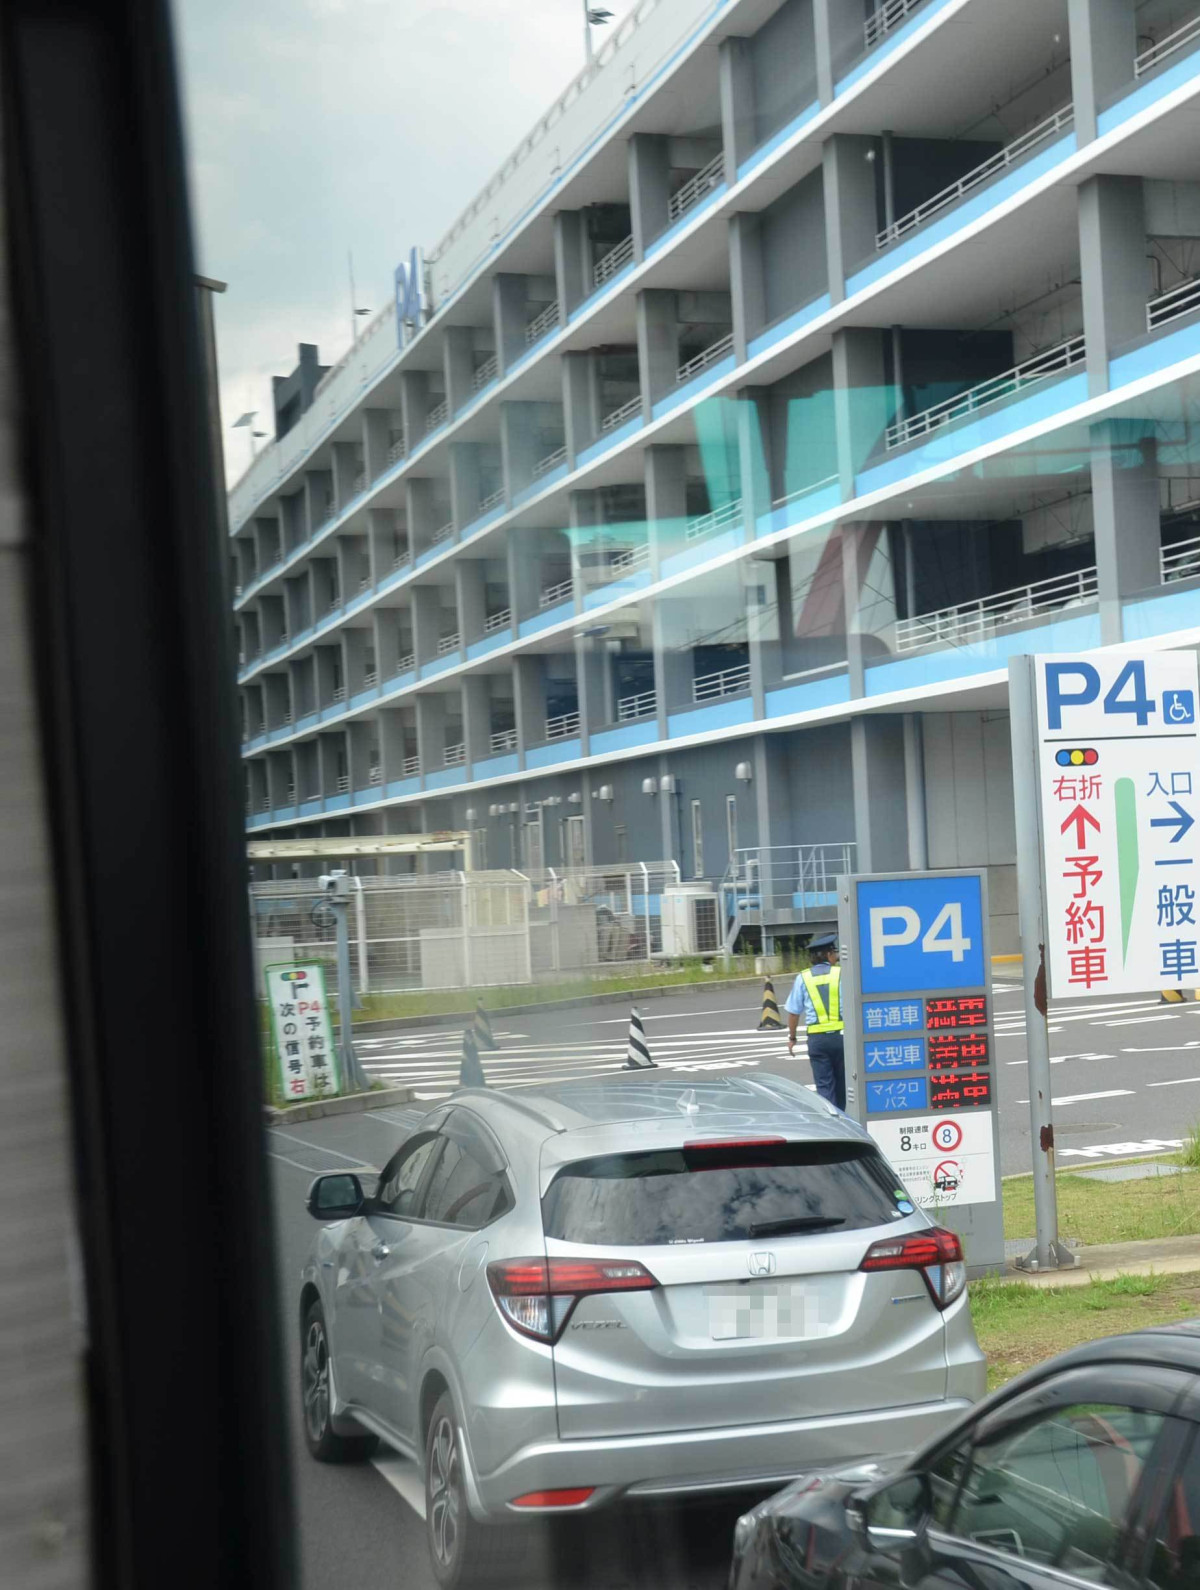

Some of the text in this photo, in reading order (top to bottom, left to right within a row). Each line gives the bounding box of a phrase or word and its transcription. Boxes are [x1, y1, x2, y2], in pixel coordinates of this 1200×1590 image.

[1044, 660, 1156, 730] P4
[1052, 774, 1103, 801] 右折
[1146, 771, 1193, 797] 入口
[1062, 855, 1109, 989] 予約車
[1154, 858, 1199, 982] 一般車
[869, 902, 972, 968] P4
[297, 1000, 321, 1015] P4
[865, 1004, 920, 1029] 普通車
[304, 1016, 331, 1089] 予約車は
[867, 1044, 922, 1068] 大型車
[872, 1082, 920, 1097] マイクロ
[885, 1096, 909, 1110] バス
[899, 1125, 929, 1135] 制限速度
[942, 1128, 952, 1143] 8
[571, 1320, 628, 1330] VEZEL
